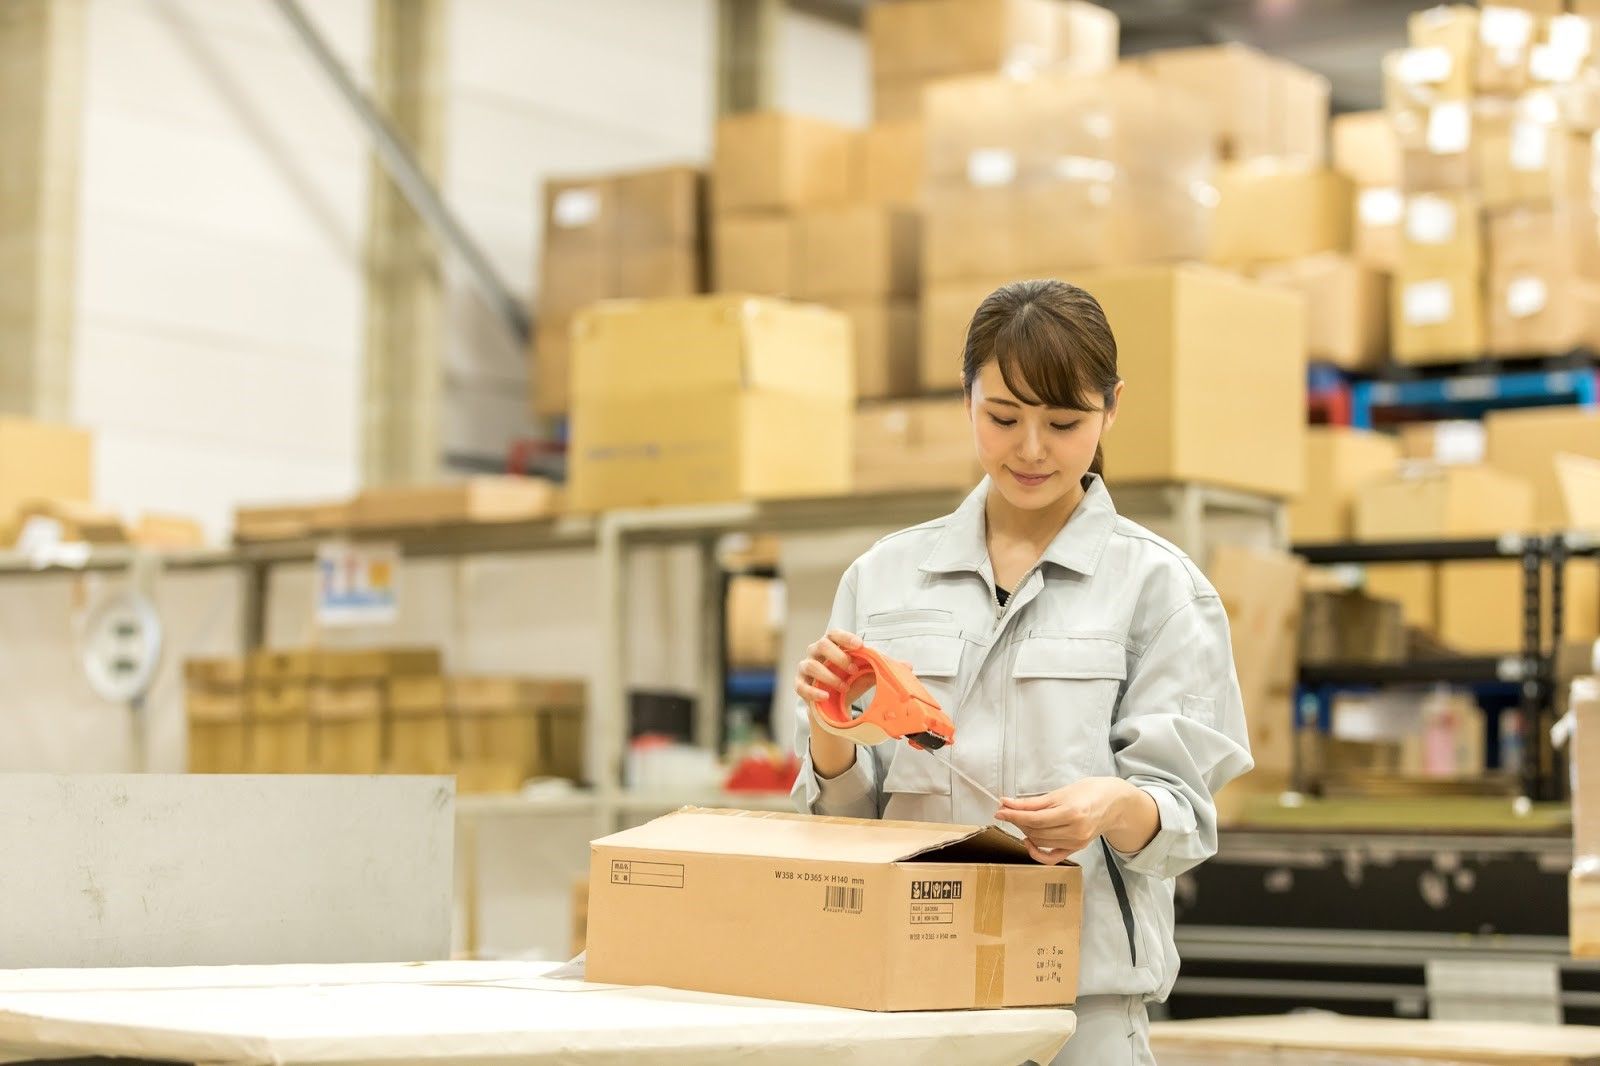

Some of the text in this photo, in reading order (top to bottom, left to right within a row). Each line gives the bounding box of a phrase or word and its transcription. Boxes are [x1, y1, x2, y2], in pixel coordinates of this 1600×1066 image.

[774, 870, 794, 880] W358
[804, 872, 822, 882] D365
[831, 875, 849, 884] H140
